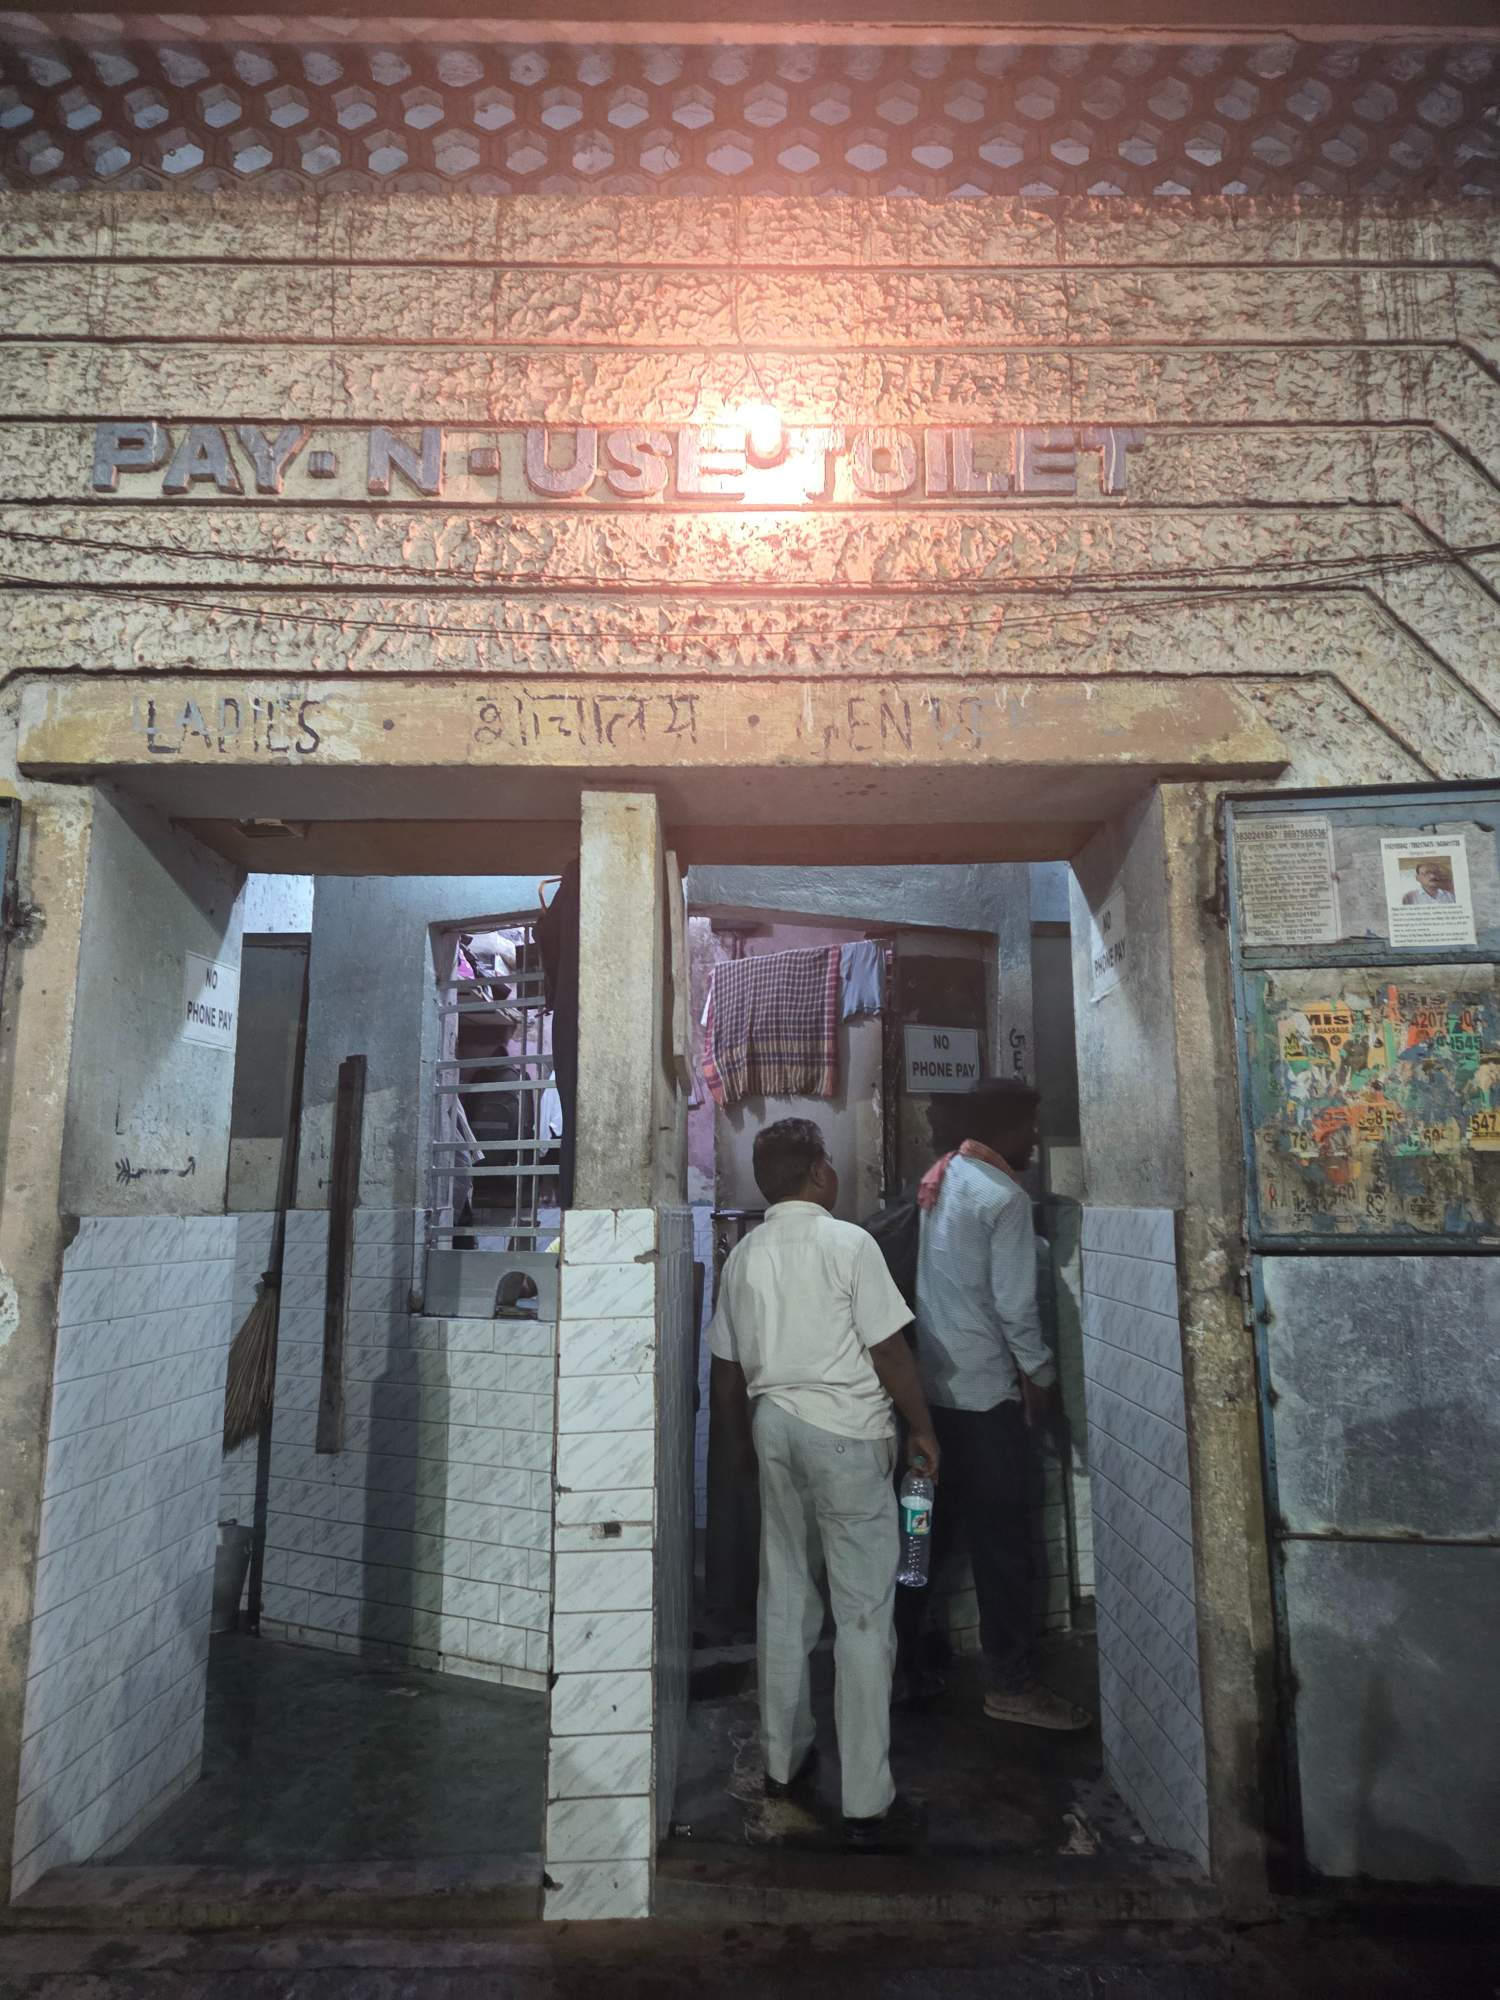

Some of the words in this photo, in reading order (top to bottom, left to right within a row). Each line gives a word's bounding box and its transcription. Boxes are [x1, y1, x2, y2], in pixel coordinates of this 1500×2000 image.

[92, 422, 311, 495] PAY
[525, 425, 748, 499] USE
[146, 697, 321, 754] LADIES
[205, 966, 218, 990] NO
[186, 1001, 217, 1028] PHONE
[218, 1010, 233, 1031] PAY
[933, 1034, 950, 1050] NO
[912, 1061, 953, 1077] PHONE
[956, 1063, 976, 1078] PAY
